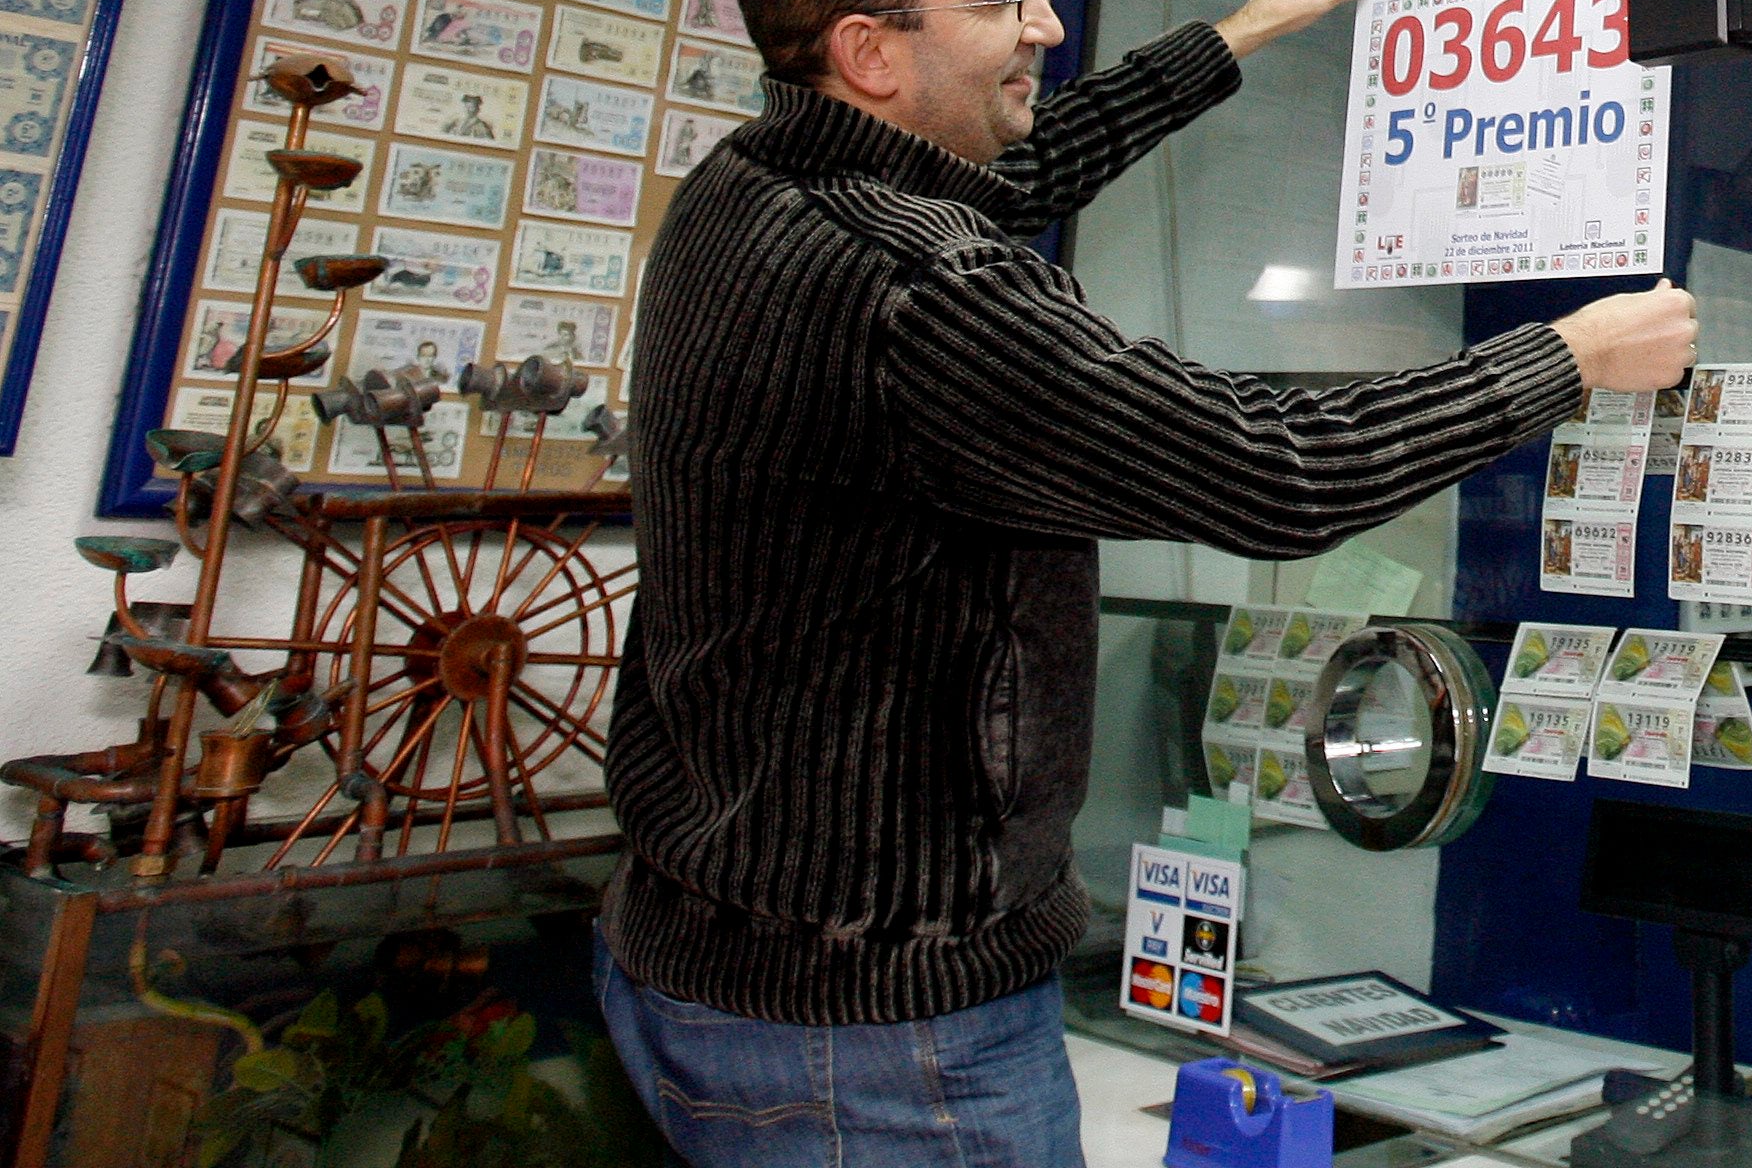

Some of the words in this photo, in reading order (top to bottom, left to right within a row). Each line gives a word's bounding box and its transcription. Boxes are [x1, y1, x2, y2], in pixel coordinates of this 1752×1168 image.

[1385, 102, 1436, 166] 5º
[1443, 90, 1625, 159] Premio
[1451, 234, 1479, 244] Sorteo
[1481, 233, 1491, 242] de
[1493, 230, 1527, 241] Navidad
[1445, 248, 1454, 257] 22
[1456, 247, 1466, 256] de
[1468, 244, 1511, 256] diciembre
[1513, 242, 1533, 253] 2011
[1575, 527, 1615, 539] 69622
[1707, 532, 1752, 544] 92836
[1551, 637, 1590, 650] 19135
[1653, 641, 1696, 655] 13119
[1530, 712, 1570, 726] 19135
[1627, 712, 1670, 728] 13119
[1142, 860, 1180, 886] VISA
[1191, 870, 1229, 898] VISA
[1269, 983, 1399, 1013] CLIENTES
[1321, 1007, 1441, 1037] NAVIDAD
